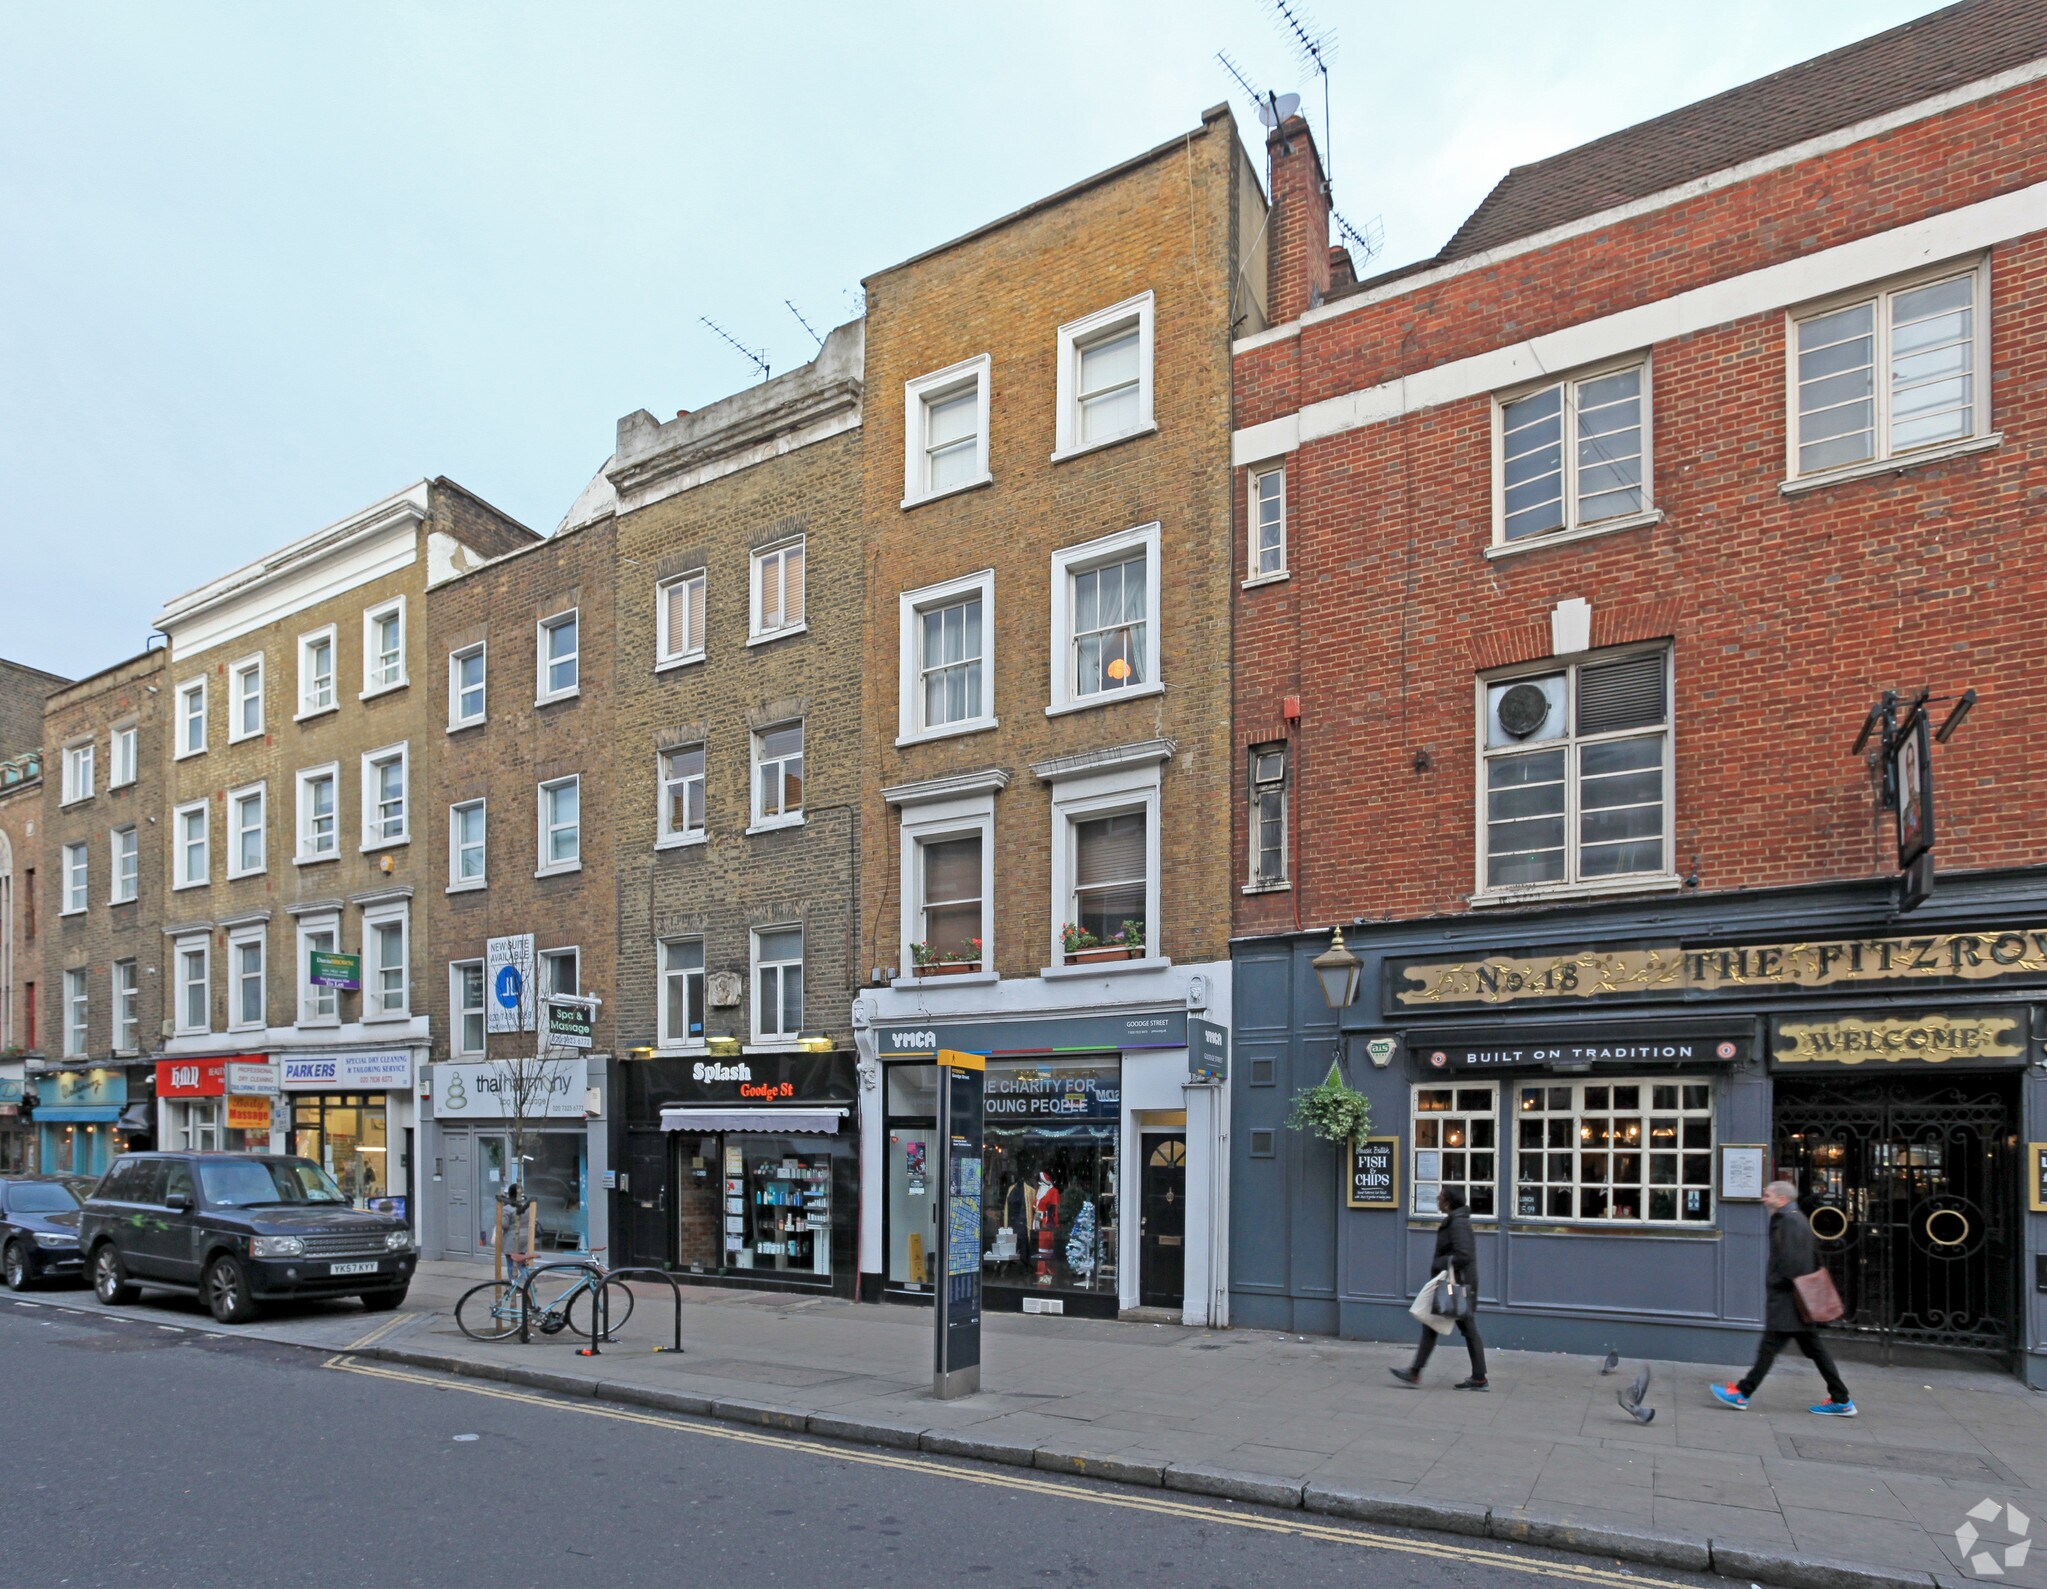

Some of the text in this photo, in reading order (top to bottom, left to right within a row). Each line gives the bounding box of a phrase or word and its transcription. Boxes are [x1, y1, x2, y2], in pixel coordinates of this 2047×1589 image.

[490, 942, 505, 952] NEW
[1685, 949, 1784, 981] THE
[556, 1009, 583, 1020] Spa &
[550, 1021, 590, 1034] Massage
[892, 1031, 936, 1048] YMCA
[1204, 1030, 1222, 1046] YMCA
[1808, 1027, 1980, 1051] WELCOME
[1466, 1046, 1692, 1063] BUILT ON TRADITION
[286, 1064, 336, 1078] PARKERS
[692, 1062, 752, 1084] Splash
[740, 1082, 794, 1102] Goodge St
[1000, 1080, 1061, 1093] CHARITY
[1066, 1078, 1096, 1092] FOR
[1030, 1098, 1088, 1112] PEOPLE
[229, 1108, 268, 1121] Massage
[1358, 1156, 1387, 1168] FISH
[1355, 1174, 1390, 1186] CHIPS
[334, 1263, 375, 1273] YK57 KYY
